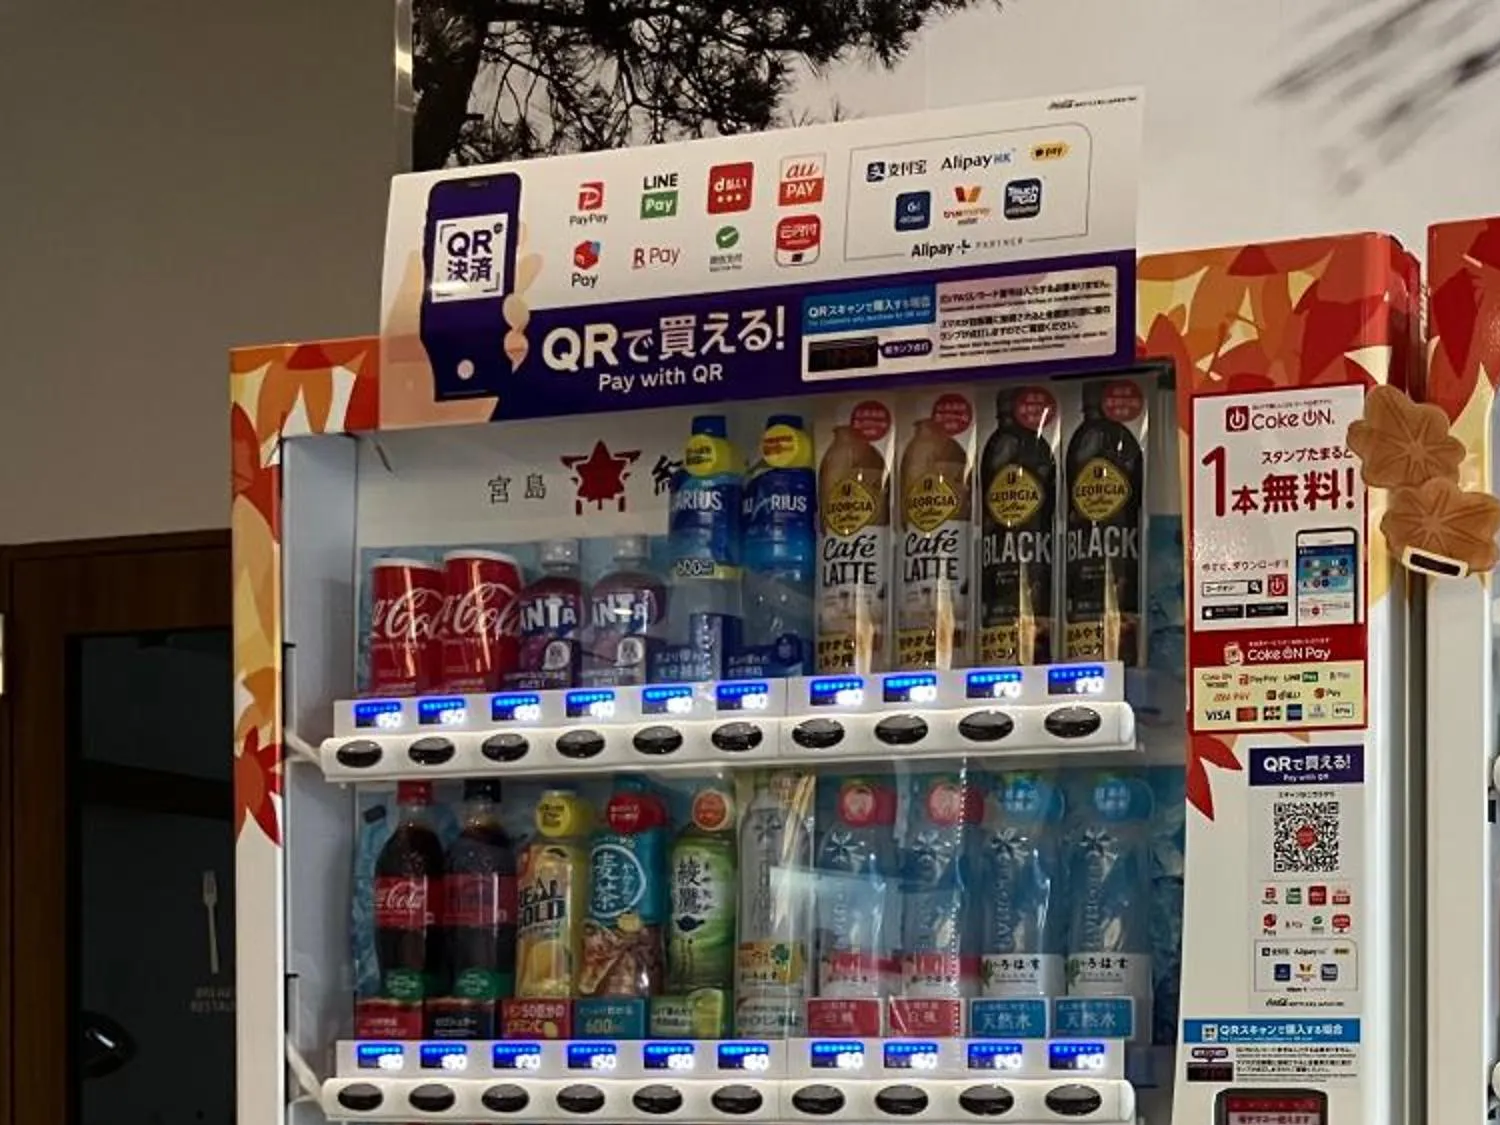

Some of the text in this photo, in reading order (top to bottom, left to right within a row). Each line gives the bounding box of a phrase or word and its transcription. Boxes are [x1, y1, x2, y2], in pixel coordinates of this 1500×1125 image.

[786, 160, 819, 179] au
[643, 173, 678, 190] LINE
[785, 181, 816, 198] PAY
[643, 194, 674, 213] Pay
[569, 211, 608, 226] PayPay
[447, 229, 493, 257] QR
[650, 246, 682, 266] Pay
[447, 258, 493, 283] 決済
[572, 273, 599, 288] Pay
[542, 304, 786, 372] QRで買える!
[598, 365, 723, 394] Pay with QR
[1251, 409, 1299, 432] Coke
[1262, 447, 1353, 465] スタンプたまると
[488, 473, 547, 504] 宮島
[824, 533, 877, 561] Café
[904, 528, 960, 556] Café
[983, 530, 1052, 566] BLACK
[1067, 524, 1139, 562] BLACK
[822, 562, 877, 587] LATTE
[904, 556, 960, 583] LATTE
[1247, 648, 1280, 662] Coke
[1305, 647, 1332, 662] Pay
[1205, 709, 1231, 721] VISA
[1263, 754, 1351, 773] QRで買える!
